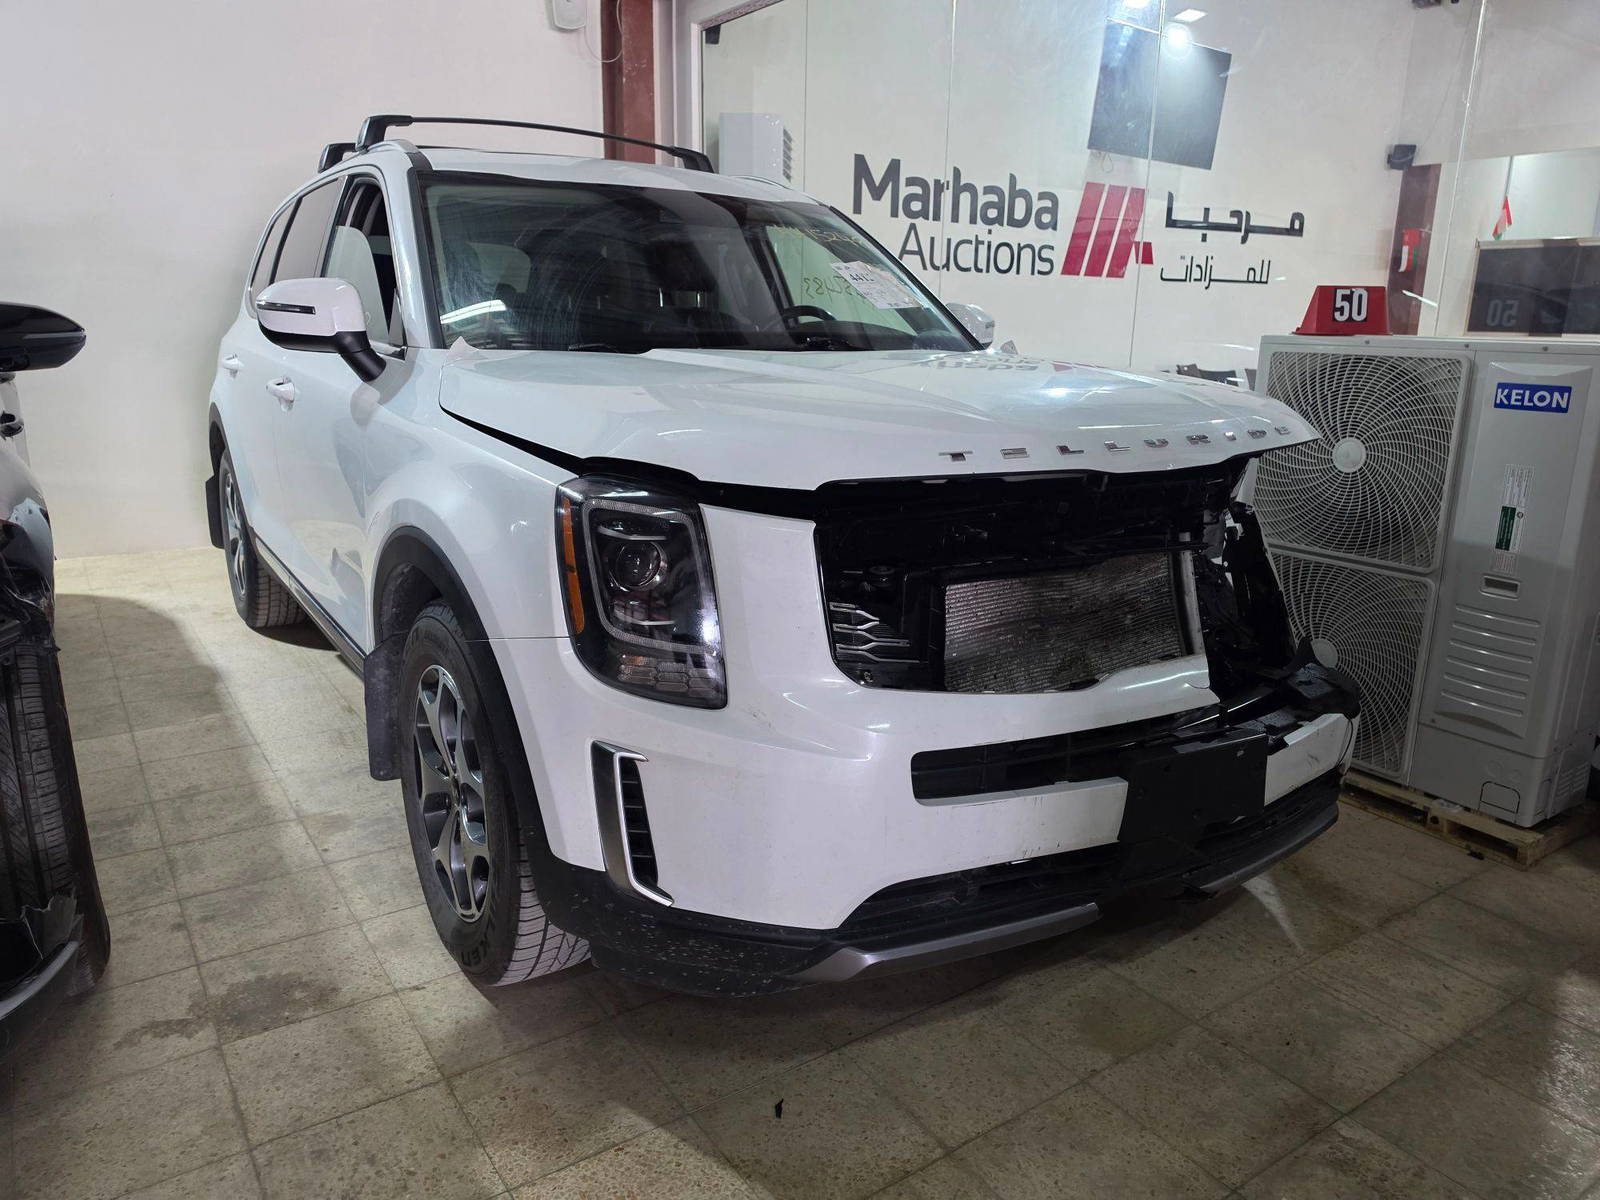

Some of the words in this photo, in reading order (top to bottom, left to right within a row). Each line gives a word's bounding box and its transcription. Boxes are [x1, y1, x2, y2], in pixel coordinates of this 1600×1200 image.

[852, 153, 1059, 232] Marhaba
[1165, 191, 1305, 244] مرحبا
[899, 222, 1055, 276] Auctions
[1160, 255, 1271, 290] للمزادات
[1333, 288, 1369, 322] 50
[1496, 388, 1570, 410] KELON
[938, 425, 1291, 462] TELLURIDE
